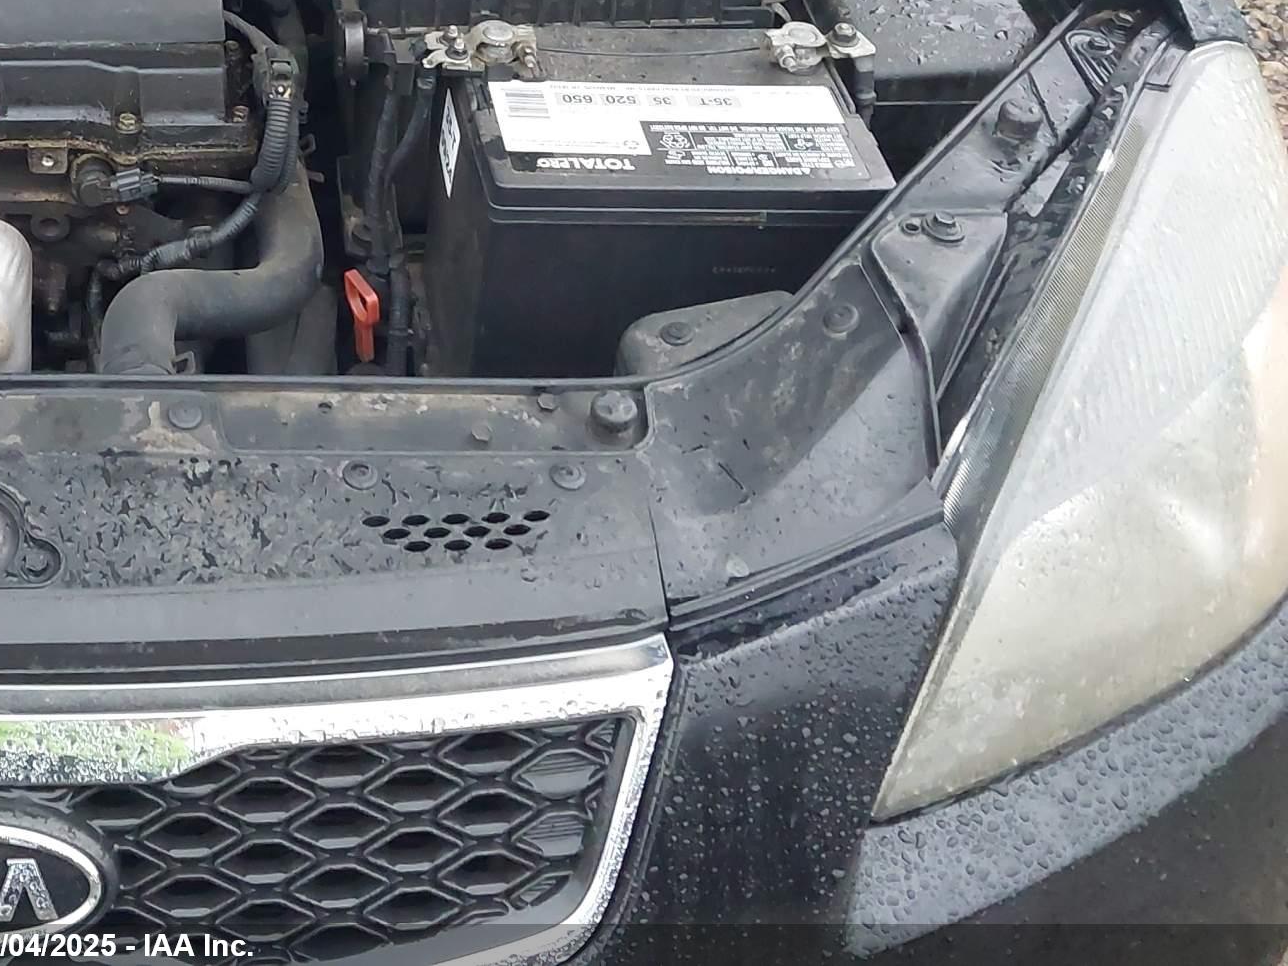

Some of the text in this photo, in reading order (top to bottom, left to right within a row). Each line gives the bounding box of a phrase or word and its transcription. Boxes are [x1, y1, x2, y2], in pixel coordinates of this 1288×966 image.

[562, 94, 733, 106] 35-T 35 520 650
[536, 156, 636, 171] TOTALPRO
